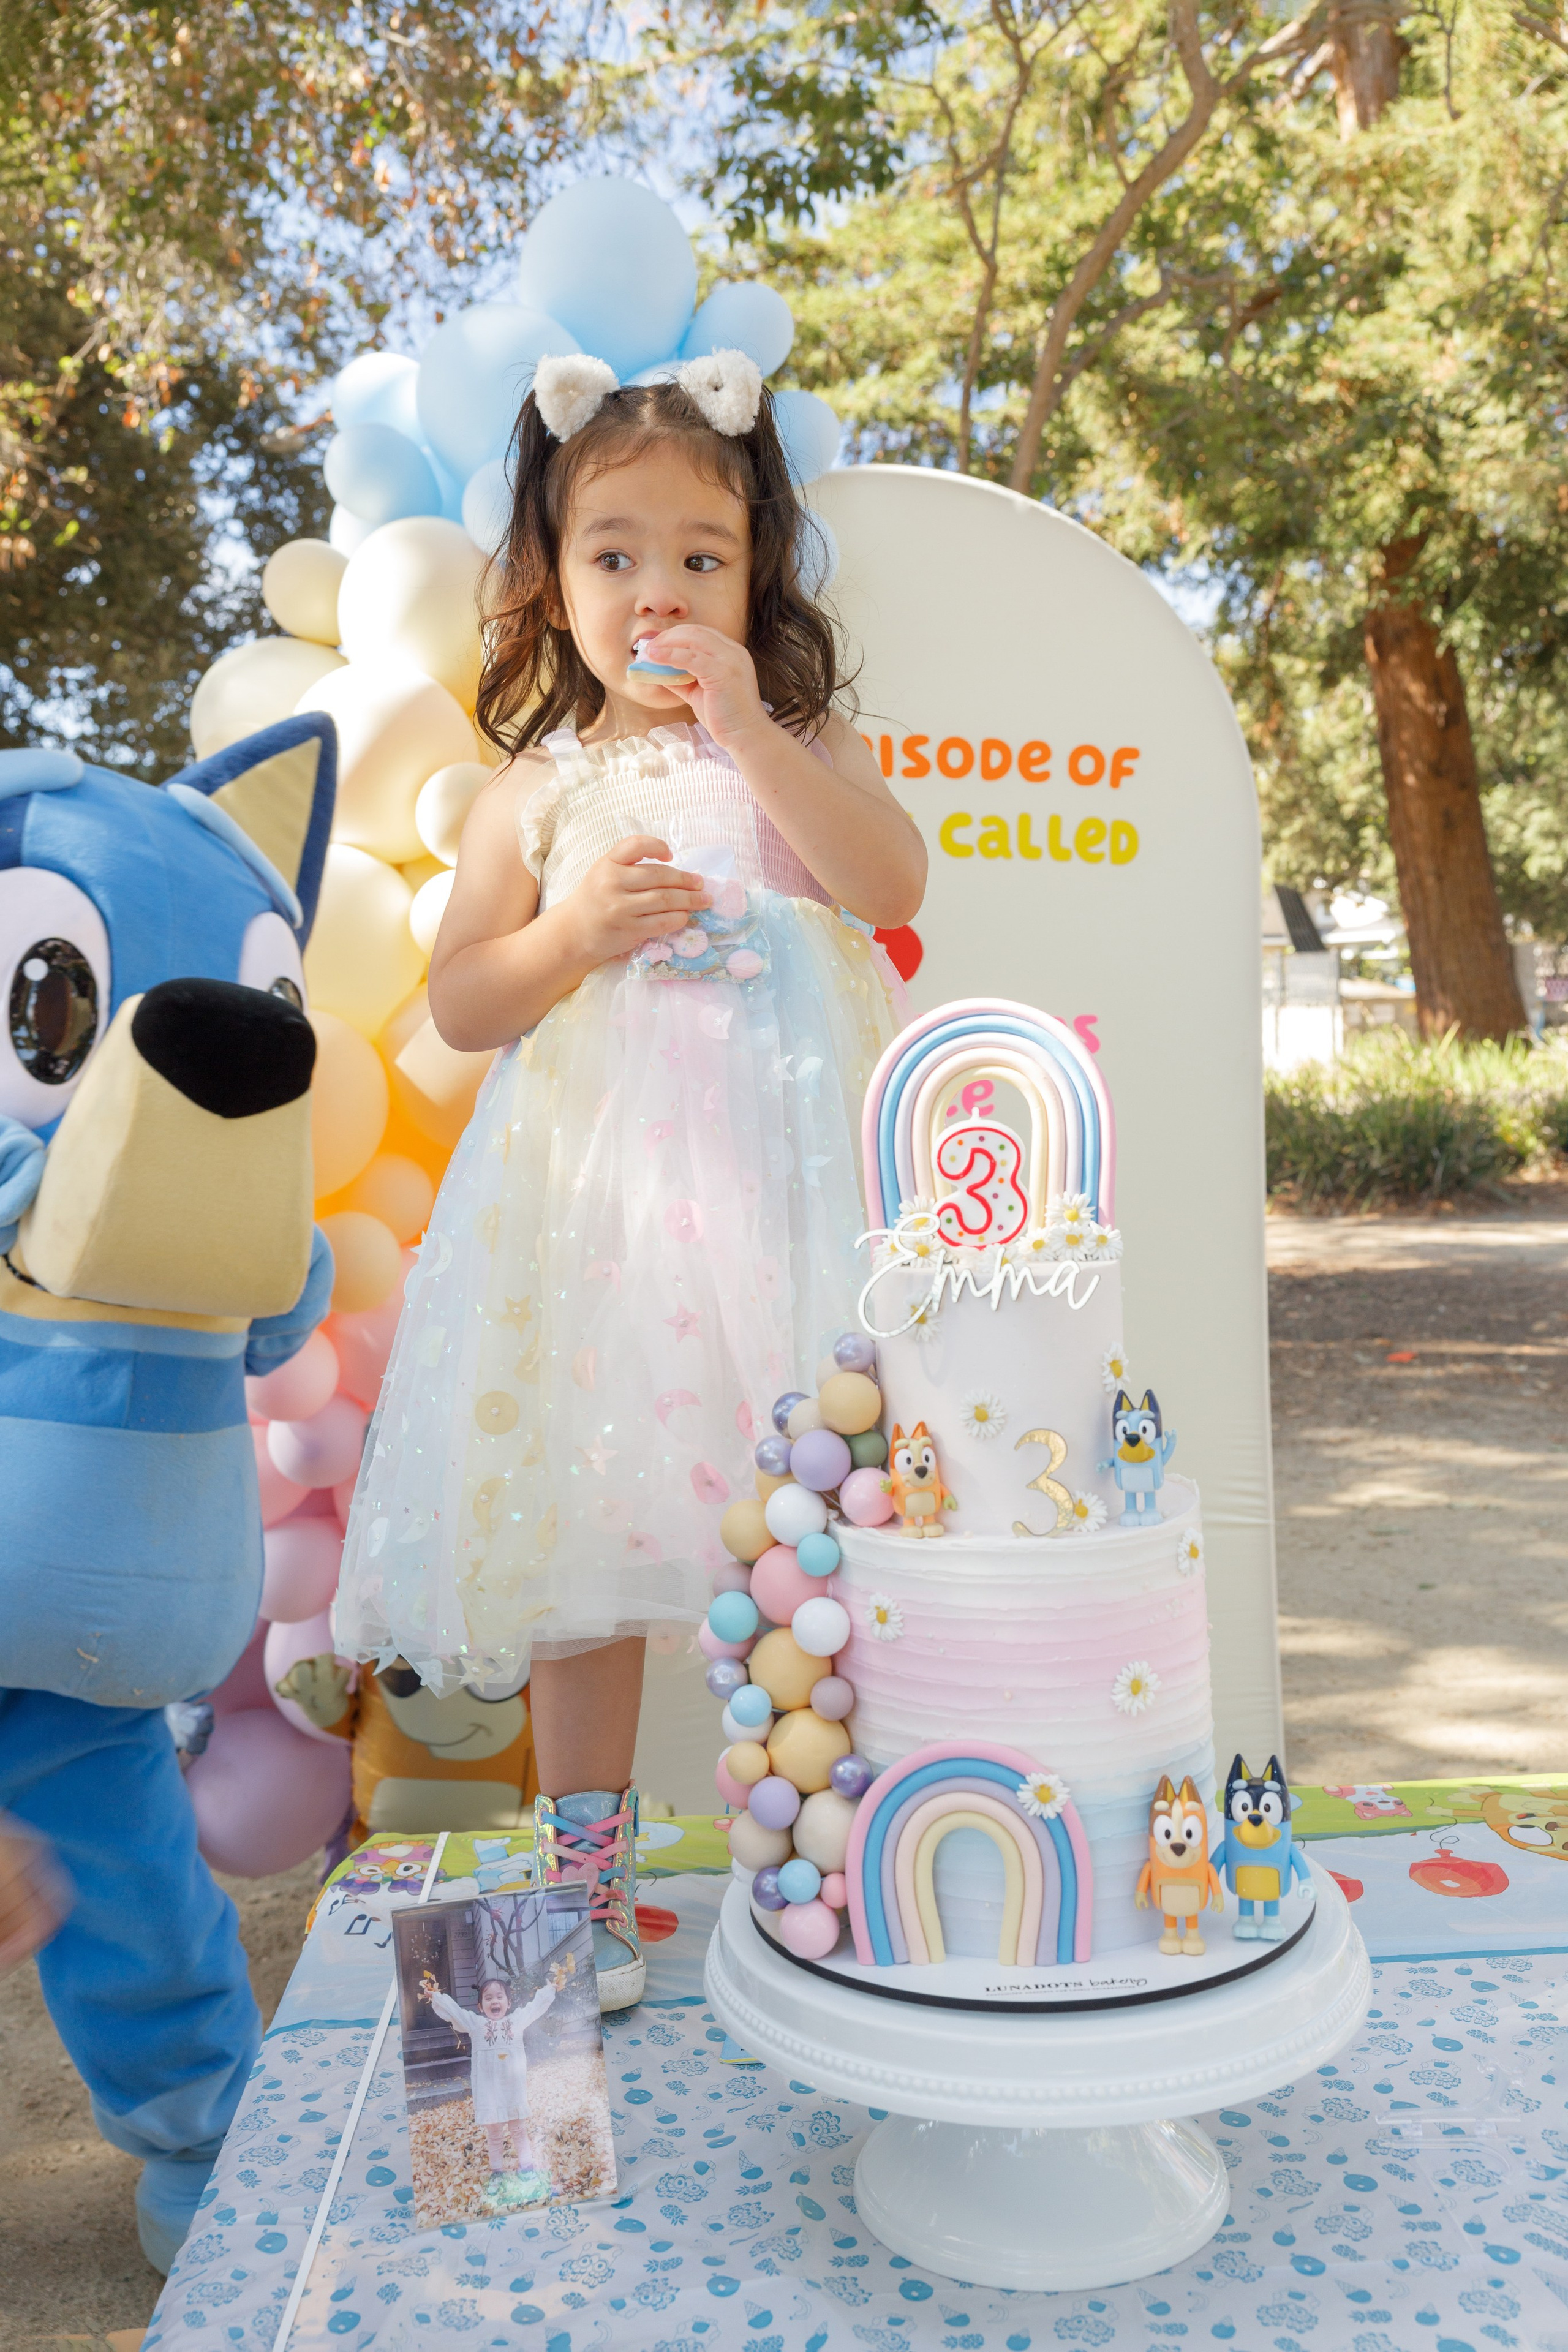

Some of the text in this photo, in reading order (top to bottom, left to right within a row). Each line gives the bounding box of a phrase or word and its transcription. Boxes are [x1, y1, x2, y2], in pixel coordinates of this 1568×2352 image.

[1068, 744, 1141, 789] OF
[933, 1116, 1031, 1251] 3
[854, 1212, 1101, 1338] Emma
[1012, 1428, 1075, 1539] 3
